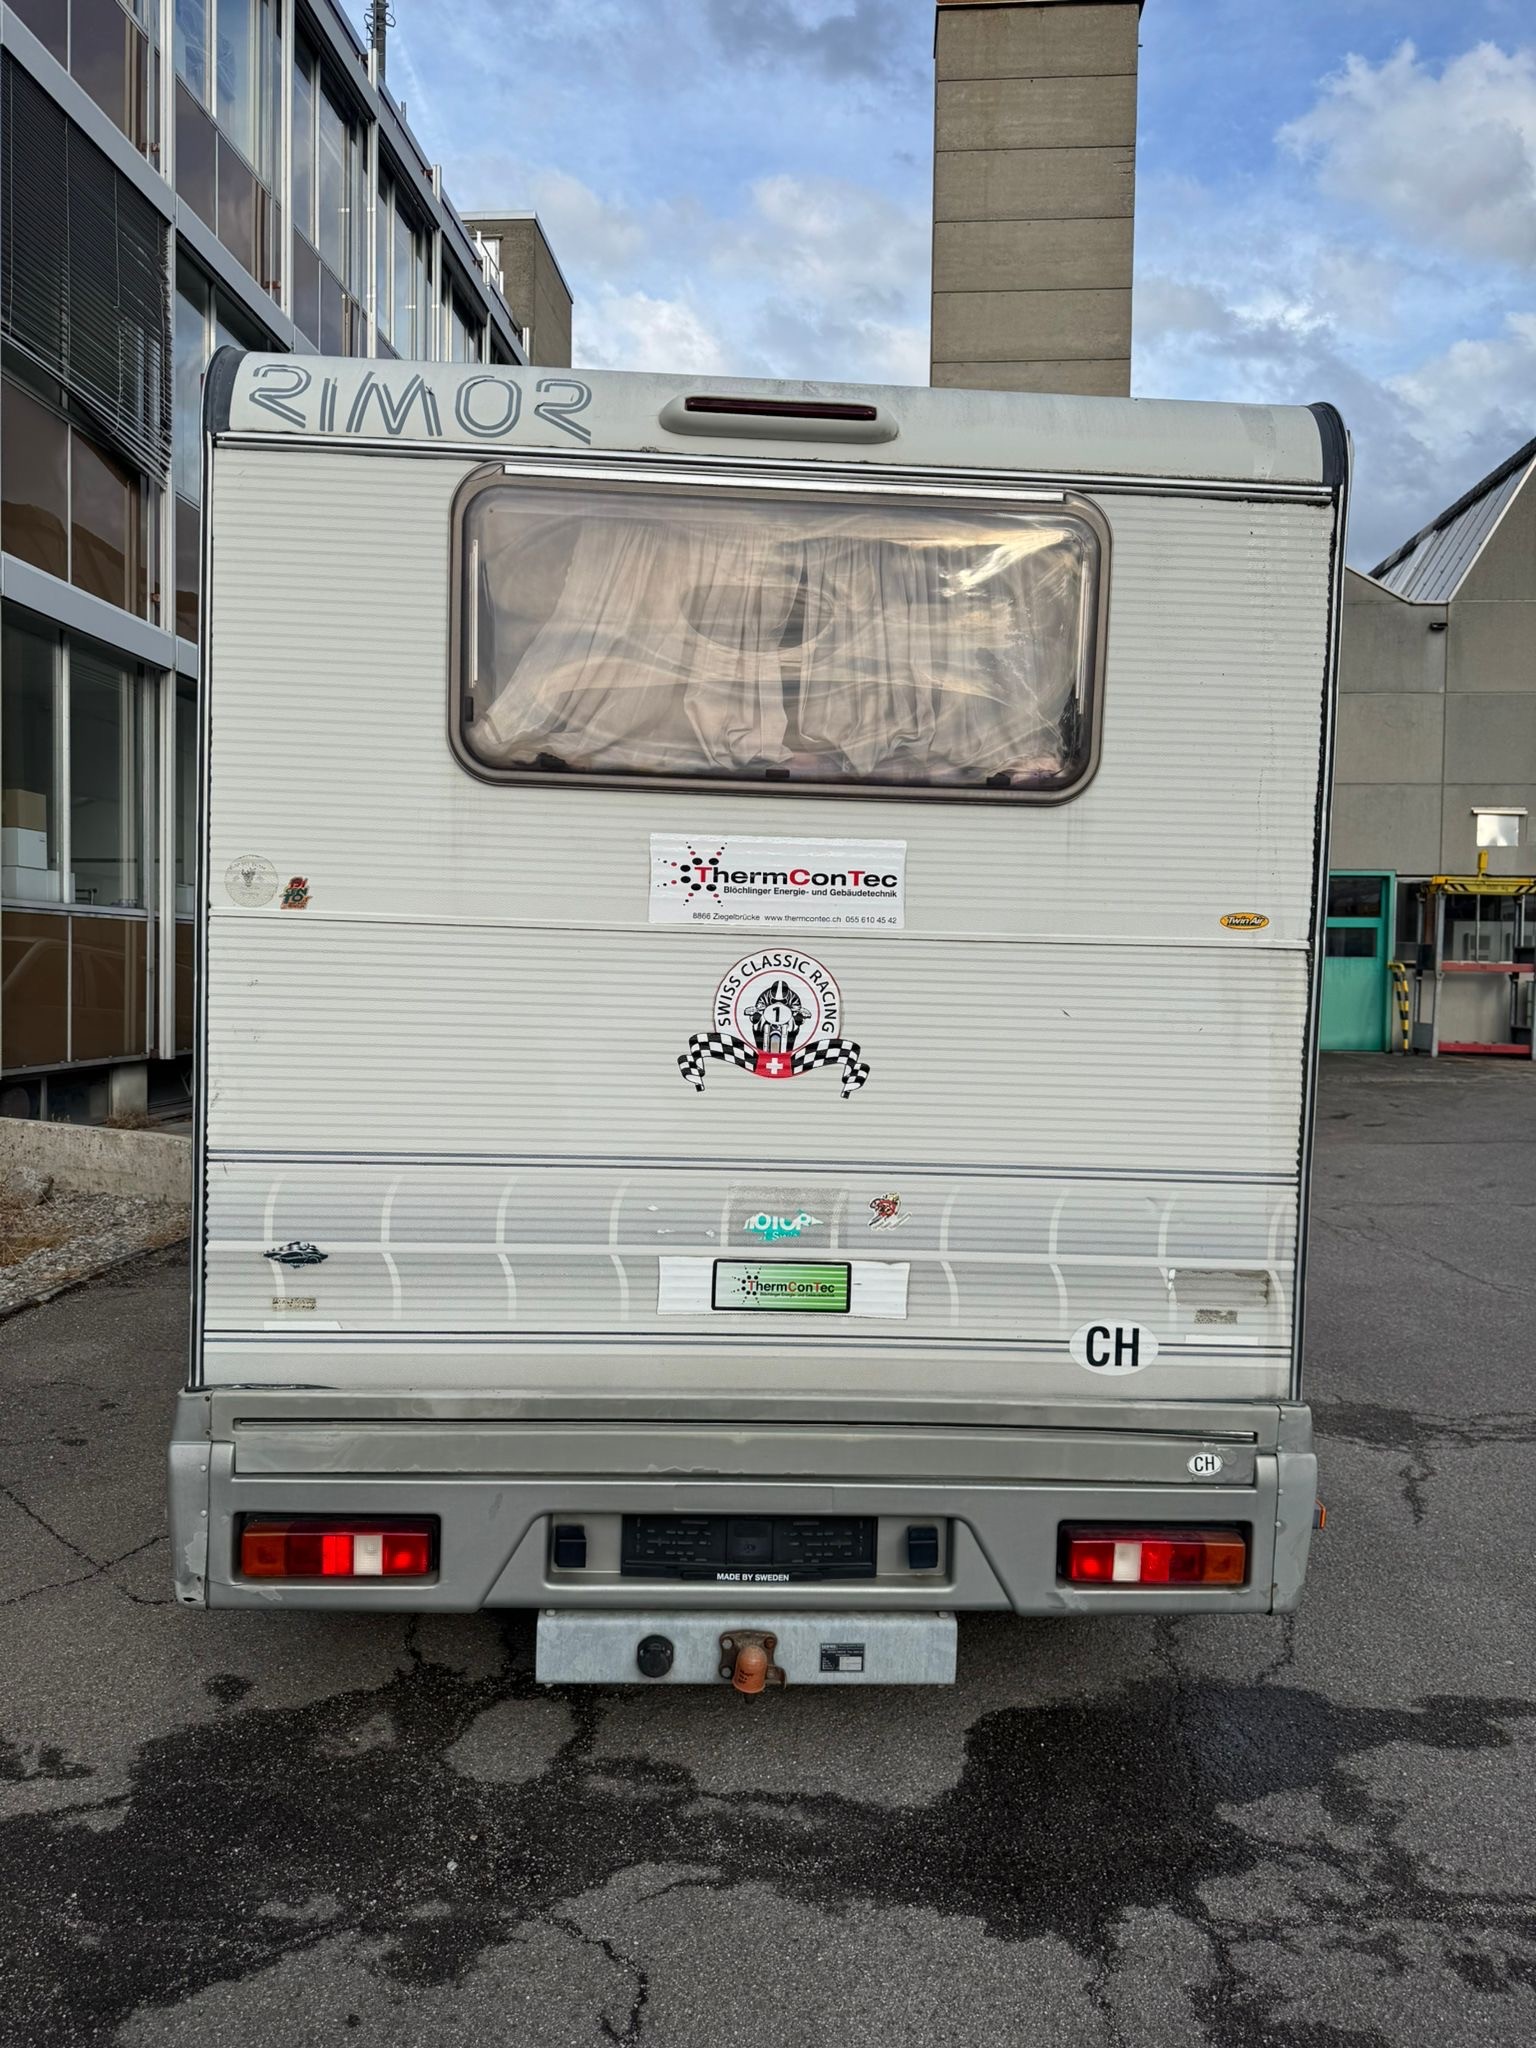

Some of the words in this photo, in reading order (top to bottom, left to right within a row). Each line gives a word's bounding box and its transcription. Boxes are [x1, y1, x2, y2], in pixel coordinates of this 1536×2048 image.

[249, 363, 592, 445] RIMOR
[694, 866, 898, 888] ThermConTec
[723, 885, 772, 896] Blöchlinger
[773, 887, 809, 897] Energie-
[811, 888, 828, 896] und
[829, 888, 897, 898] Gebäudetechnik
[692, 912, 711, 920] 8866
[713, 912, 760, 922] Ziegelbrücke
[764, 914, 842, 923] www.thermcontec.ch
[845, 915, 859, 923] 055
[861, 916, 875, 924] 610
[876, 916, 887, 924] 45
[717, 976, 741, 1027] SWISS
[741, 953, 810, 977] CLASSIC
[809, 969, 837, 1034] RACING
[772, 1006, 781, 1023] 1
[748, 1280, 835, 1293] ThermConTec
[1086, 1325, 1140, 1367] CH
[1194, 1456, 1215, 1472] CH
